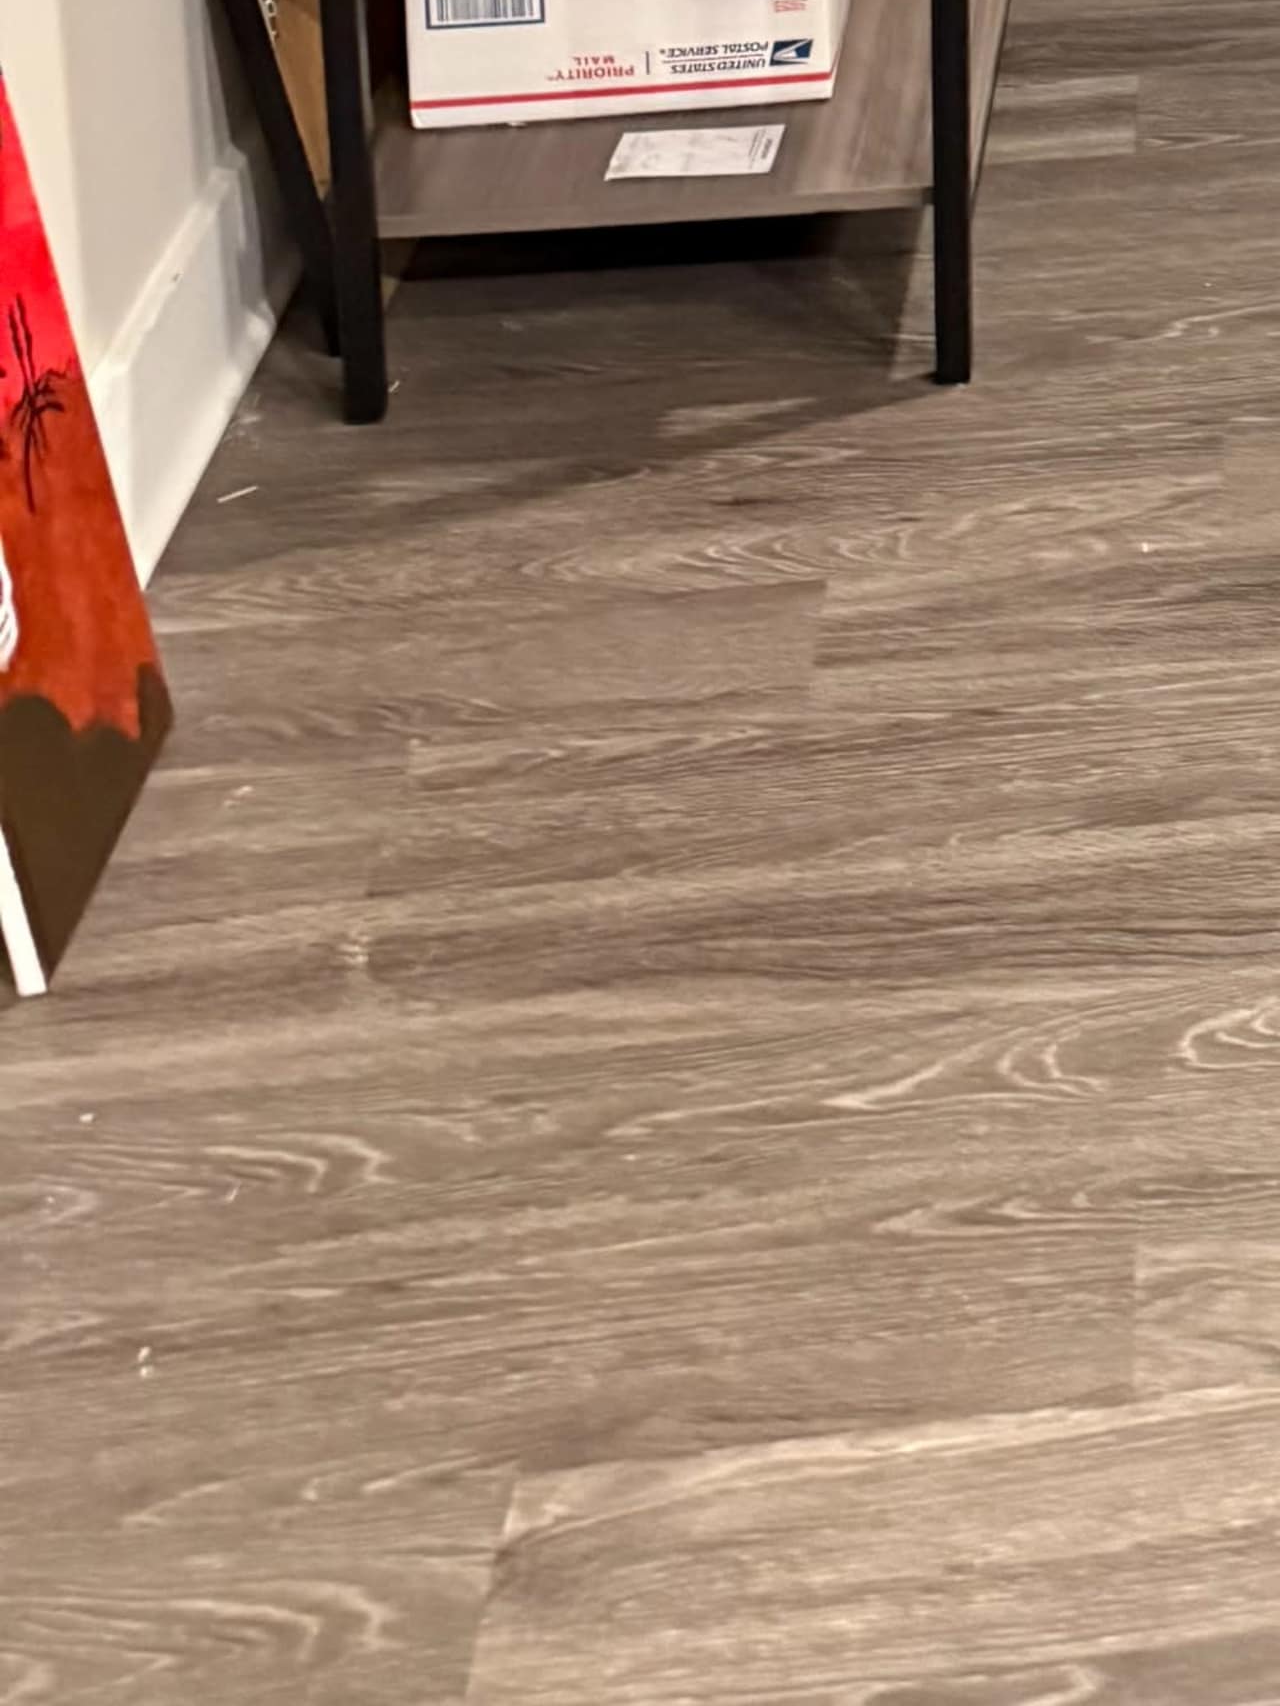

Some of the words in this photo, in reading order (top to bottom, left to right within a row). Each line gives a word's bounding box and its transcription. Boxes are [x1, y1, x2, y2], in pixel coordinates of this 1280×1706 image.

[722, 40, 769, 54] POSTAL
[573, 54, 616, 67] MAIL
[671, 60, 714, 75] STATES
[714, 58, 766, 72] UNITED
[555, 65, 635, 82] PRIORITY
